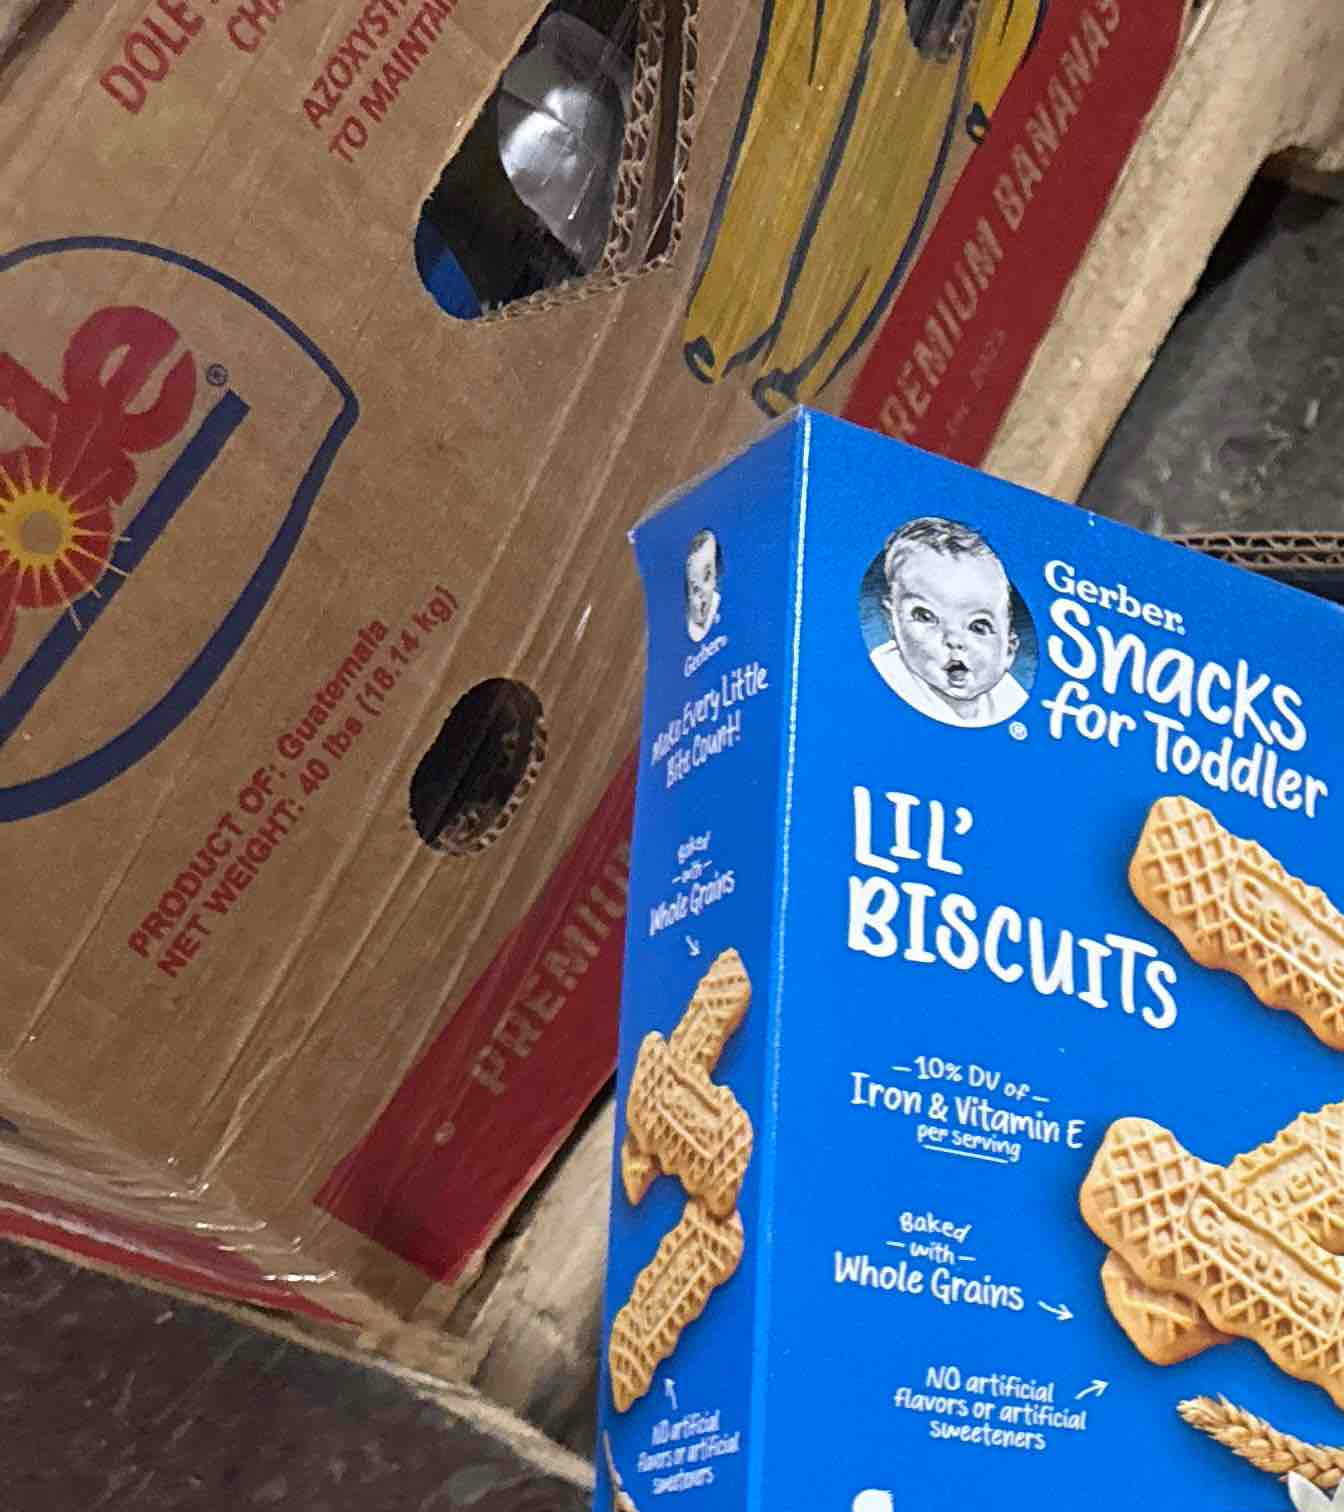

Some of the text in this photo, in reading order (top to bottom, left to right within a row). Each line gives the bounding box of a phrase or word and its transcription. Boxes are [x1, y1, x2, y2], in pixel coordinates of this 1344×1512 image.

[1048, 599, 1308, 751] Snacks
[1041, 683, 1328, 819] for Toddler
[127, 813, 244, 959] PRODUCT
[277, 619, 389, 761] Guatemala
[157, 585, 458, 978] NET WEIGHT: 40 lbs (18.14 kg)
[848, 876, 1178, 1029] BISCUITS
[915, 1056, 1001, 1092] 10% DV
[850, 1072, 1085, 1148] Iron & Vitamin E
[916, 1125, 1021, 1161] per serving
[899, 1211, 972, 1243] Baked
[910, 1239, 956, 1265] with
[834, 1252, 1024, 1311] Whole Grains
[894, 1387, 1086, 1431] flavors or artificial
[925, 1364, 1054, 1403] NO artificial
[929, 1418, 1047, 1450] sweeteners
